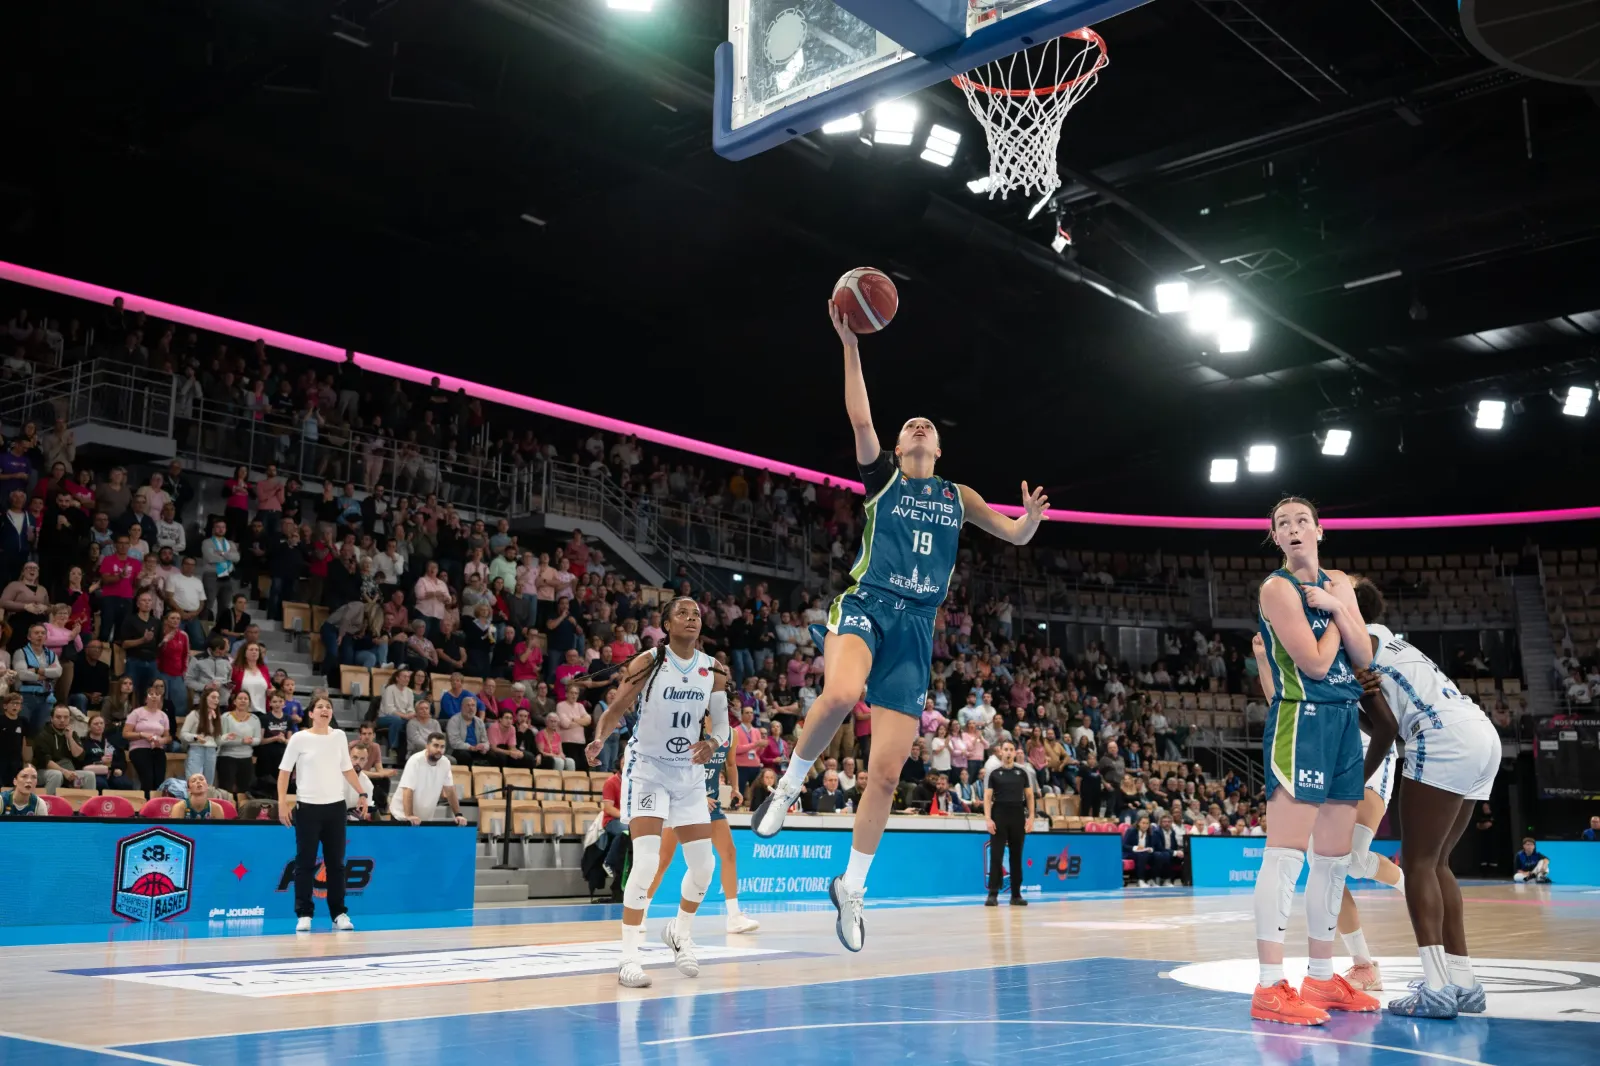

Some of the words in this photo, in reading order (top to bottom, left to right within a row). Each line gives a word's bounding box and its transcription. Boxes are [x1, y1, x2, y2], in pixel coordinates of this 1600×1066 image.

[891, 505, 959, 529] AVENIDA
[912, 530, 933, 556] 19
[662, 686, 705, 702] Chartres
[670, 711, 691, 729] 10
[752, 843, 800, 859] PROCHAIN
[802, 844, 833, 859] MATCH
[775, 876, 786, 893] 25
[787, 876, 831, 893] OCTOBRE
[154, 894, 186, 919] BASKET
[226, 905, 265, 918] JOURNÉE
